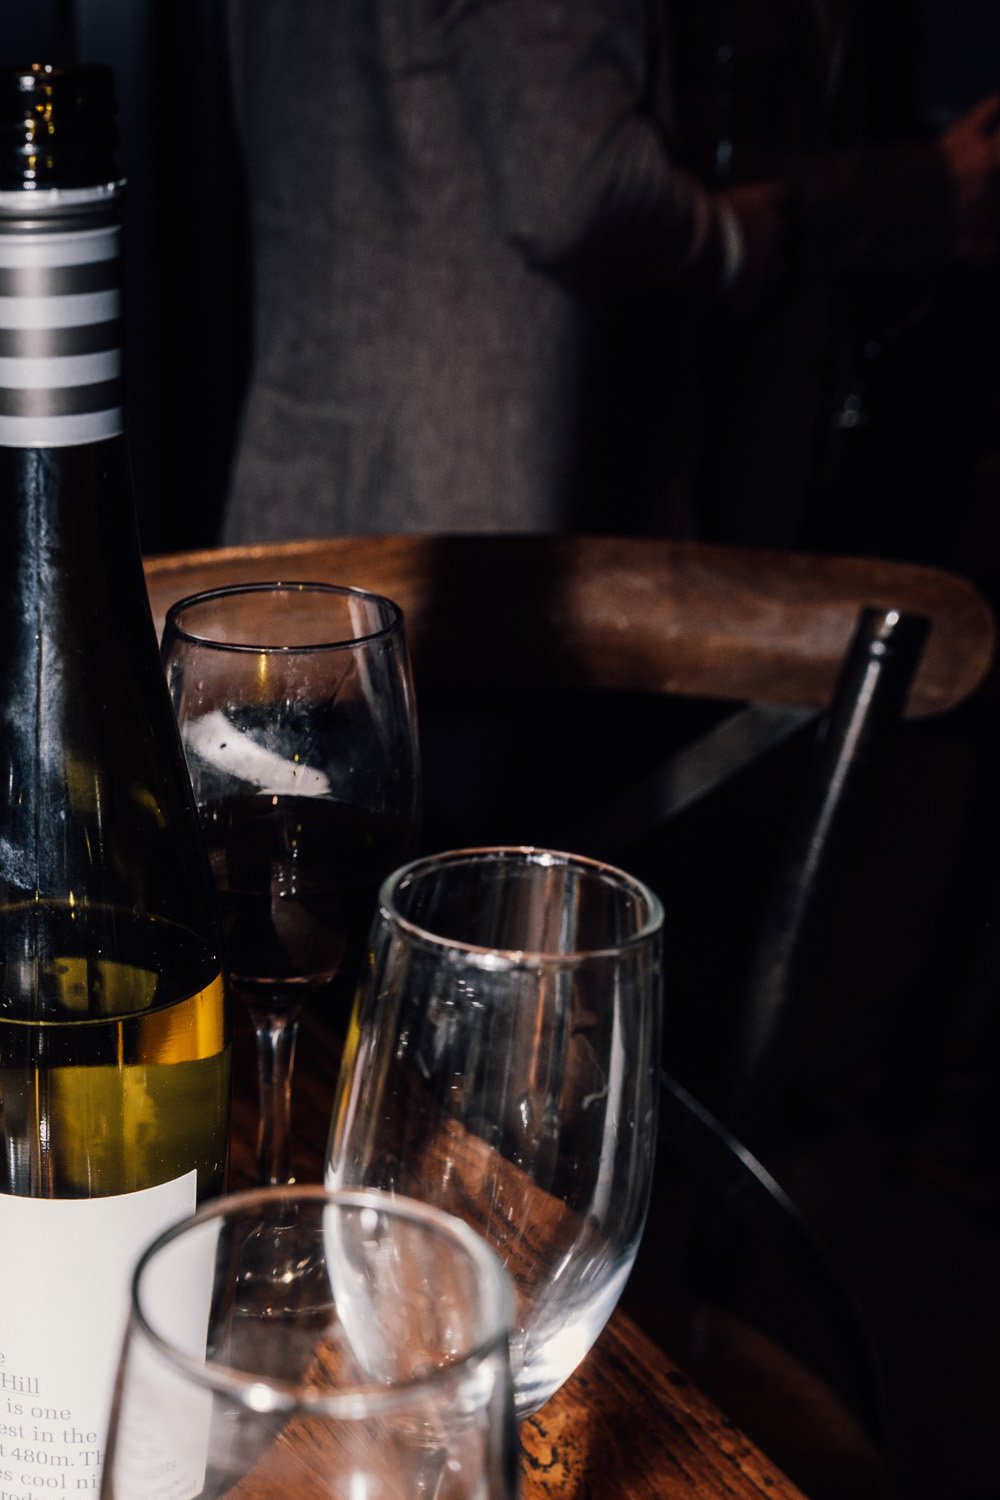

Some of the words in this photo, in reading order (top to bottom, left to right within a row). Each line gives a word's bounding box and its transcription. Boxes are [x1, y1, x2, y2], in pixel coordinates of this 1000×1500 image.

[0, 1371, 41, 1395] Hill
[6, 1398, 23, 1415] is
[31, 1407, 71, 1420] one
[33, 1426, 55, 1443] in
[62, 1428, 97, 1443] the
[11, 1448, 75, 1467] 480m.
[20, 1474, 66, 1489] cool
